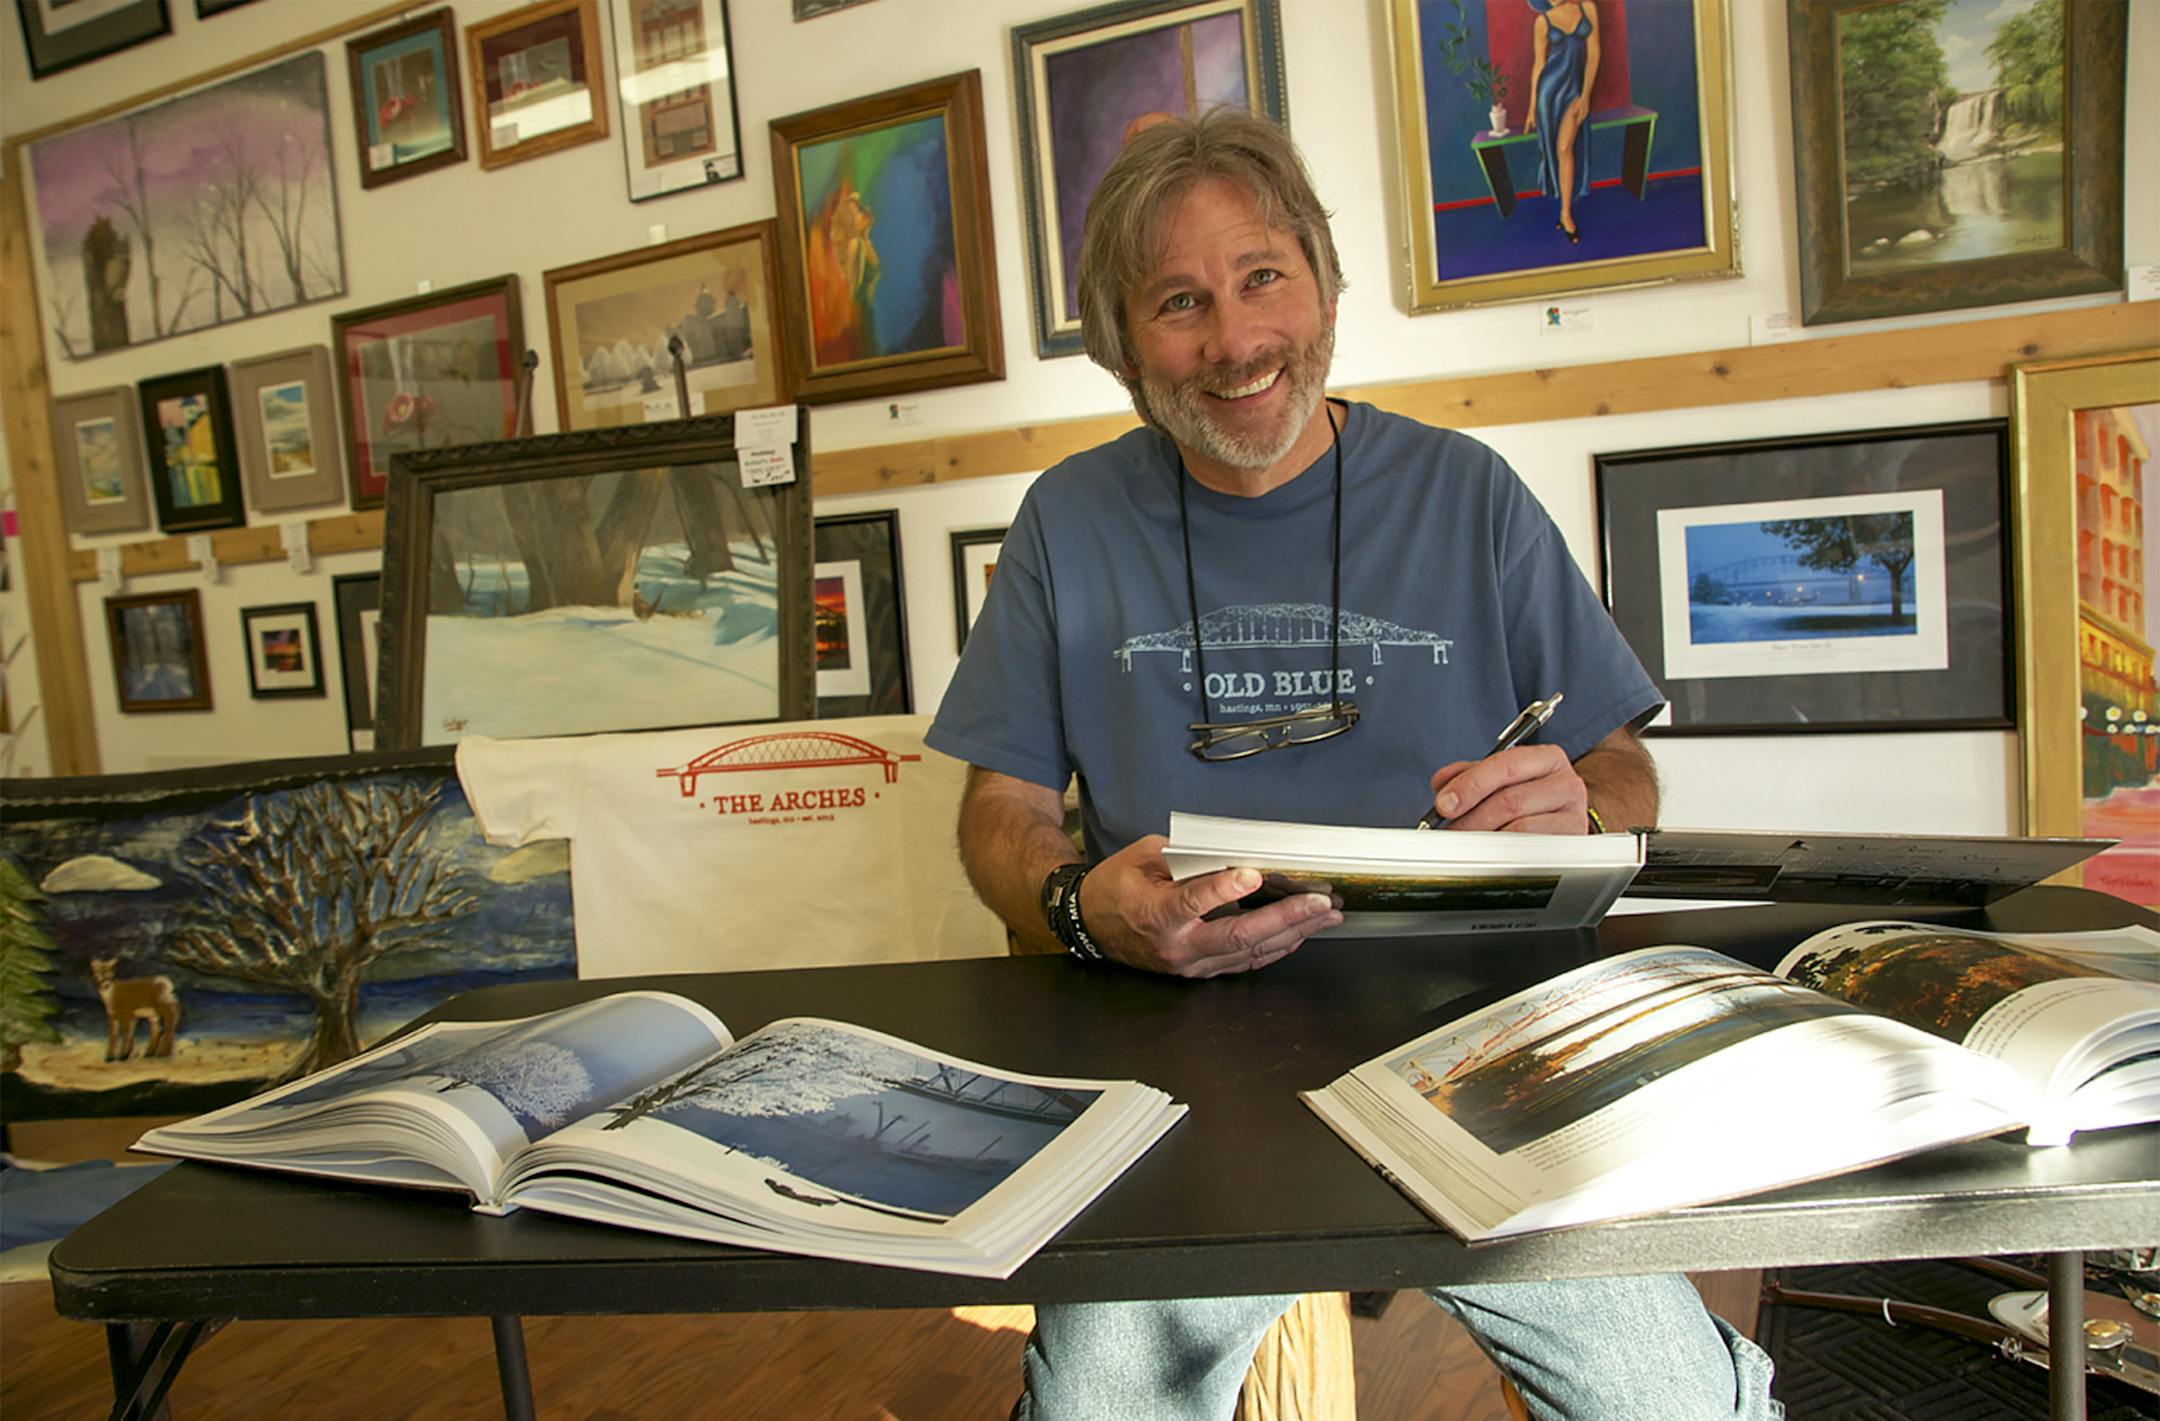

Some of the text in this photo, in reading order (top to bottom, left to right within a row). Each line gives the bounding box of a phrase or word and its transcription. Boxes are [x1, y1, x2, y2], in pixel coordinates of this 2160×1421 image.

[1204, 669, 1356, 698] OLD BLUE
[1219, 703, 1263, 714] hastings,
[1265, 703, 1281, 712] mn
[713, 787, 866, 815] THE ARCHES
